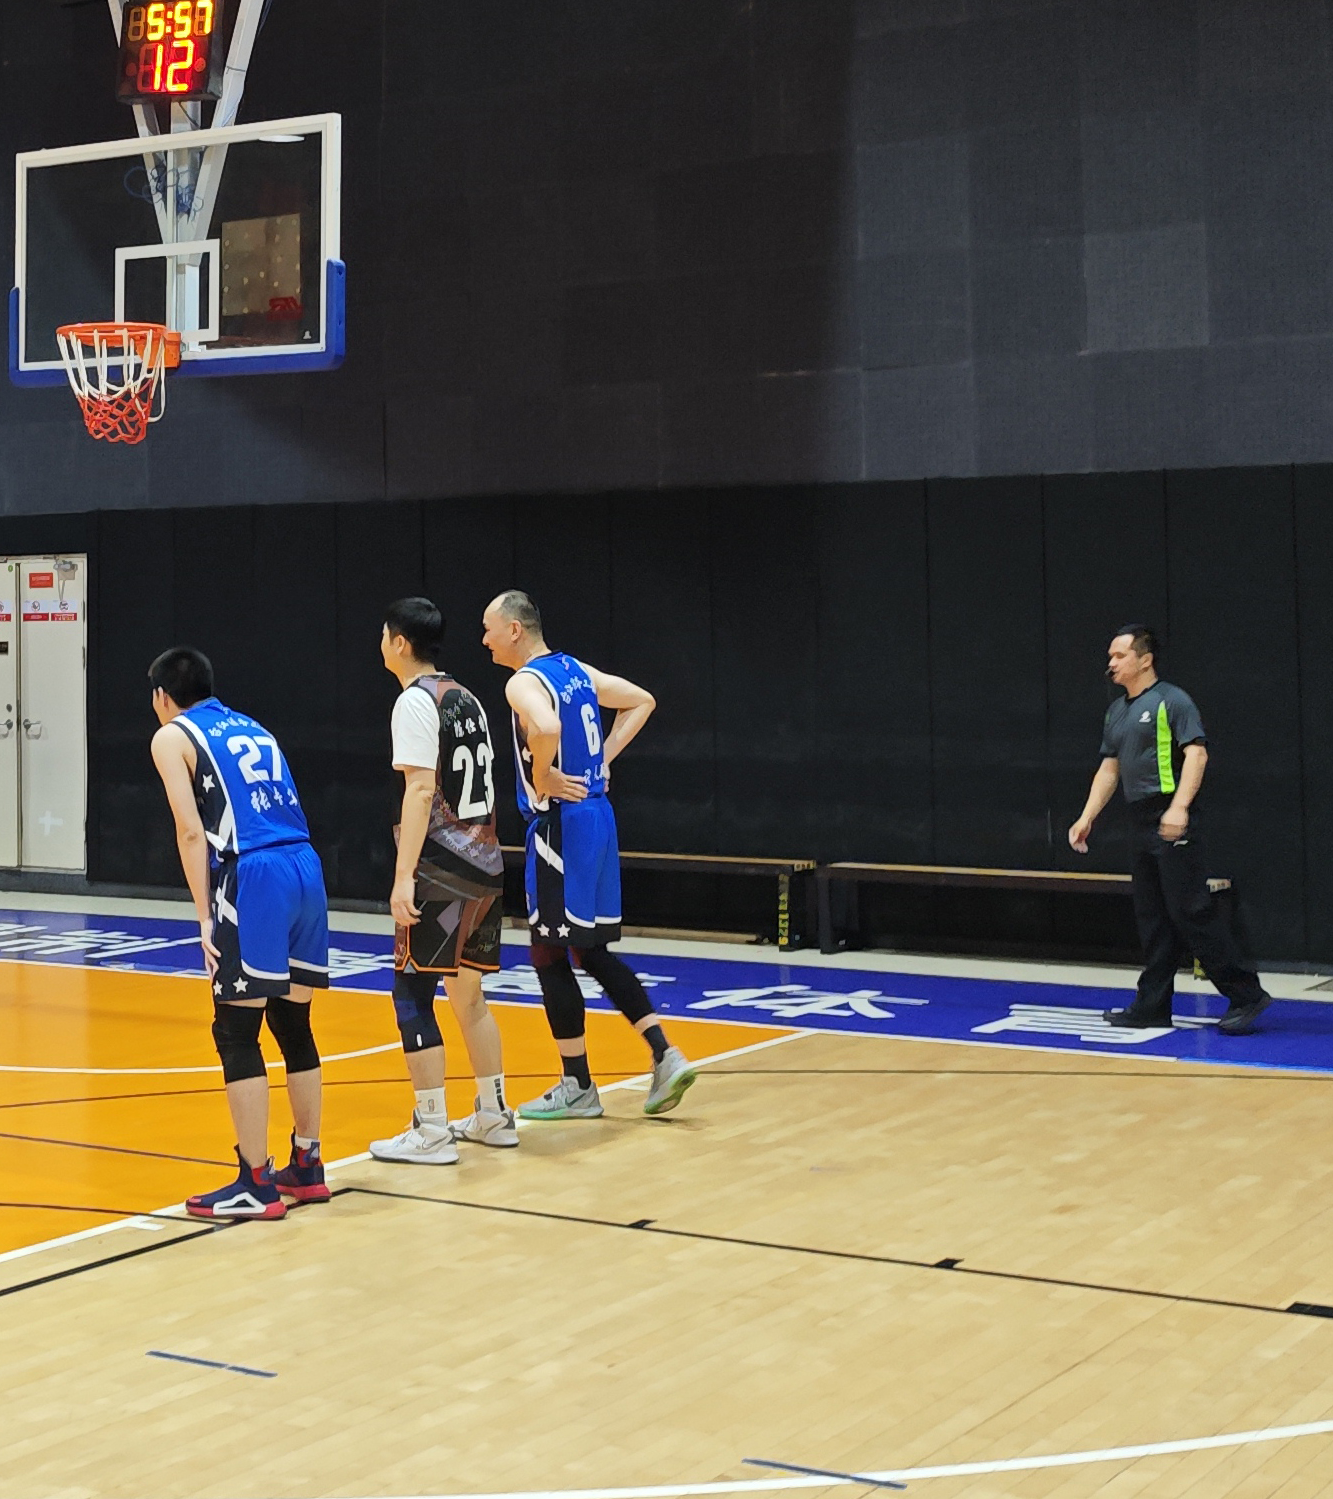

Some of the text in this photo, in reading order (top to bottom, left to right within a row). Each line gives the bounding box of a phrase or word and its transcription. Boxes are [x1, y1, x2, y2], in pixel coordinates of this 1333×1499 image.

[147, 0, 213, 41] 5:57
[154, 40, 194, 92] 12
[580, 703, 601, 757] 6
[227, 735, 282, 784] 27
[453, 742, 495, 820] 23
